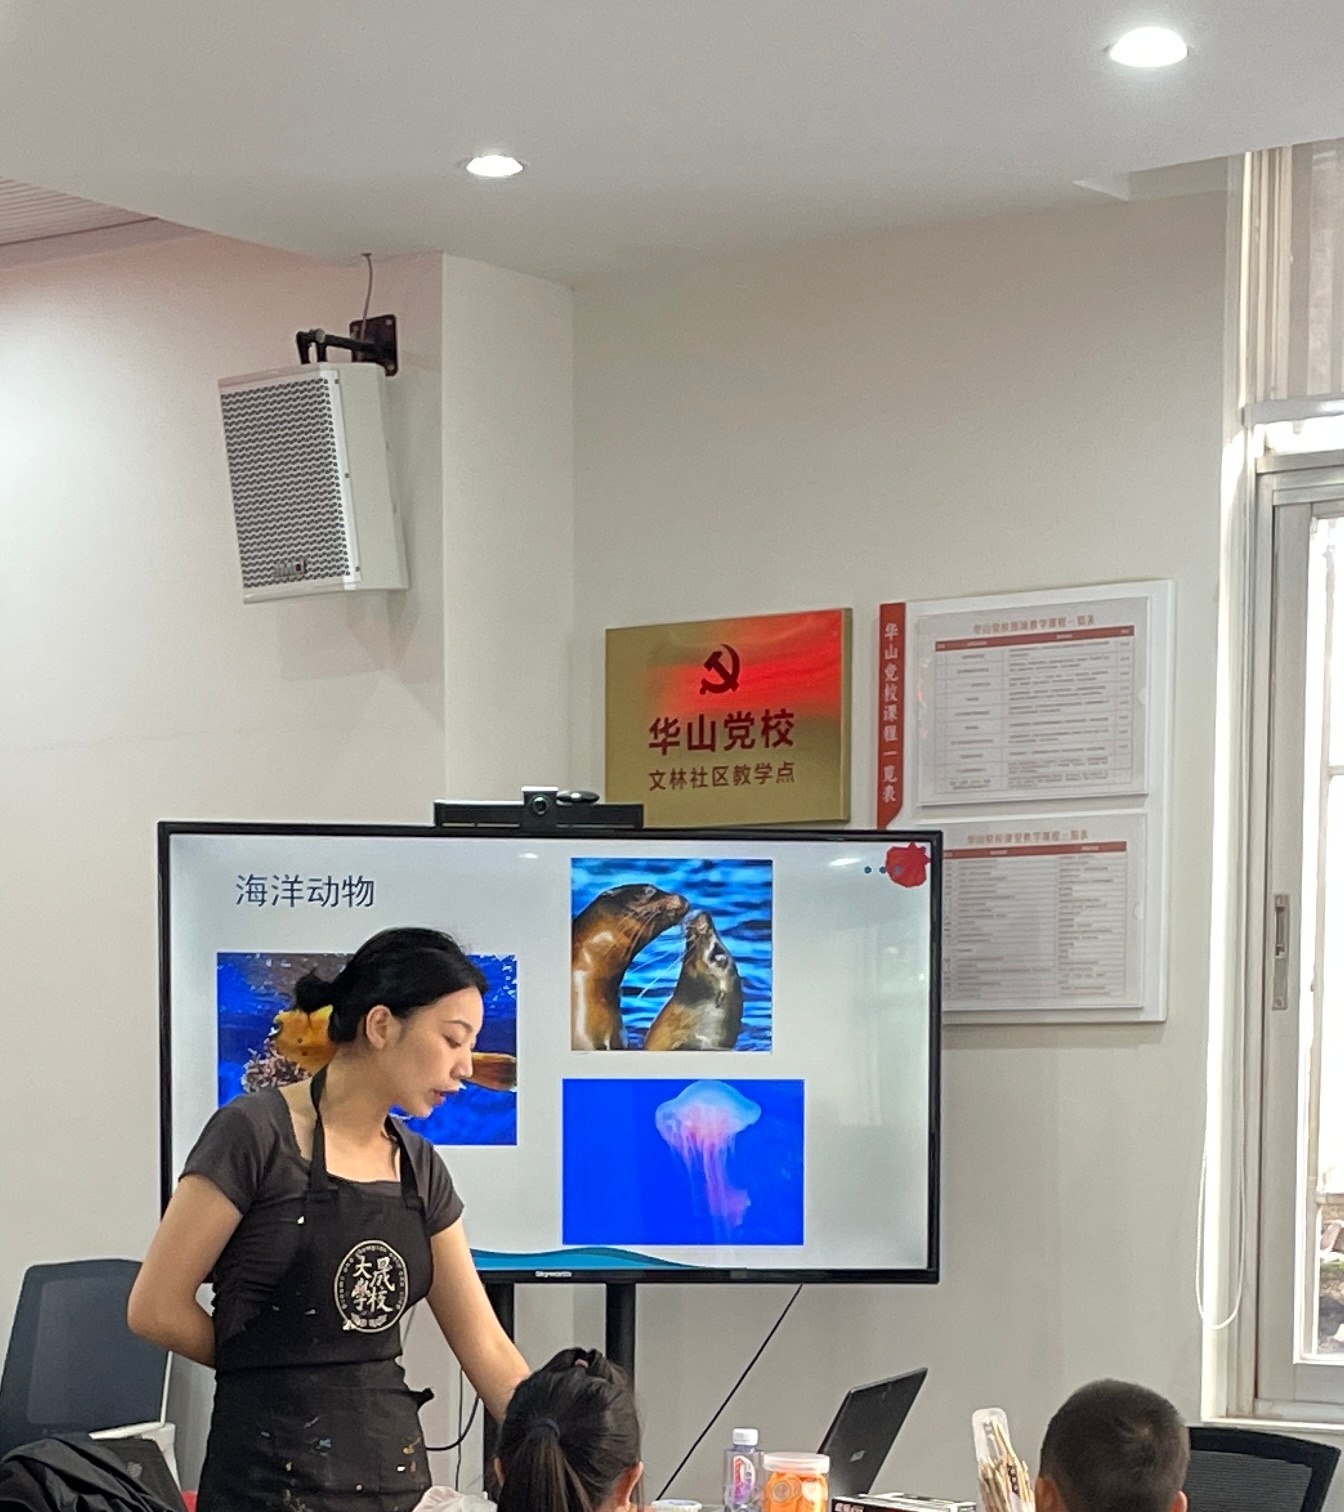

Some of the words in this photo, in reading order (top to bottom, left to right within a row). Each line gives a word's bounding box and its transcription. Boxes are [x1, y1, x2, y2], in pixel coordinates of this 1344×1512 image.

[648, 708, 795, 756] 华山党校
[648, 761, 795, 791] 文林社区教学点
[236, 873, 375, 908] 海洋动物
